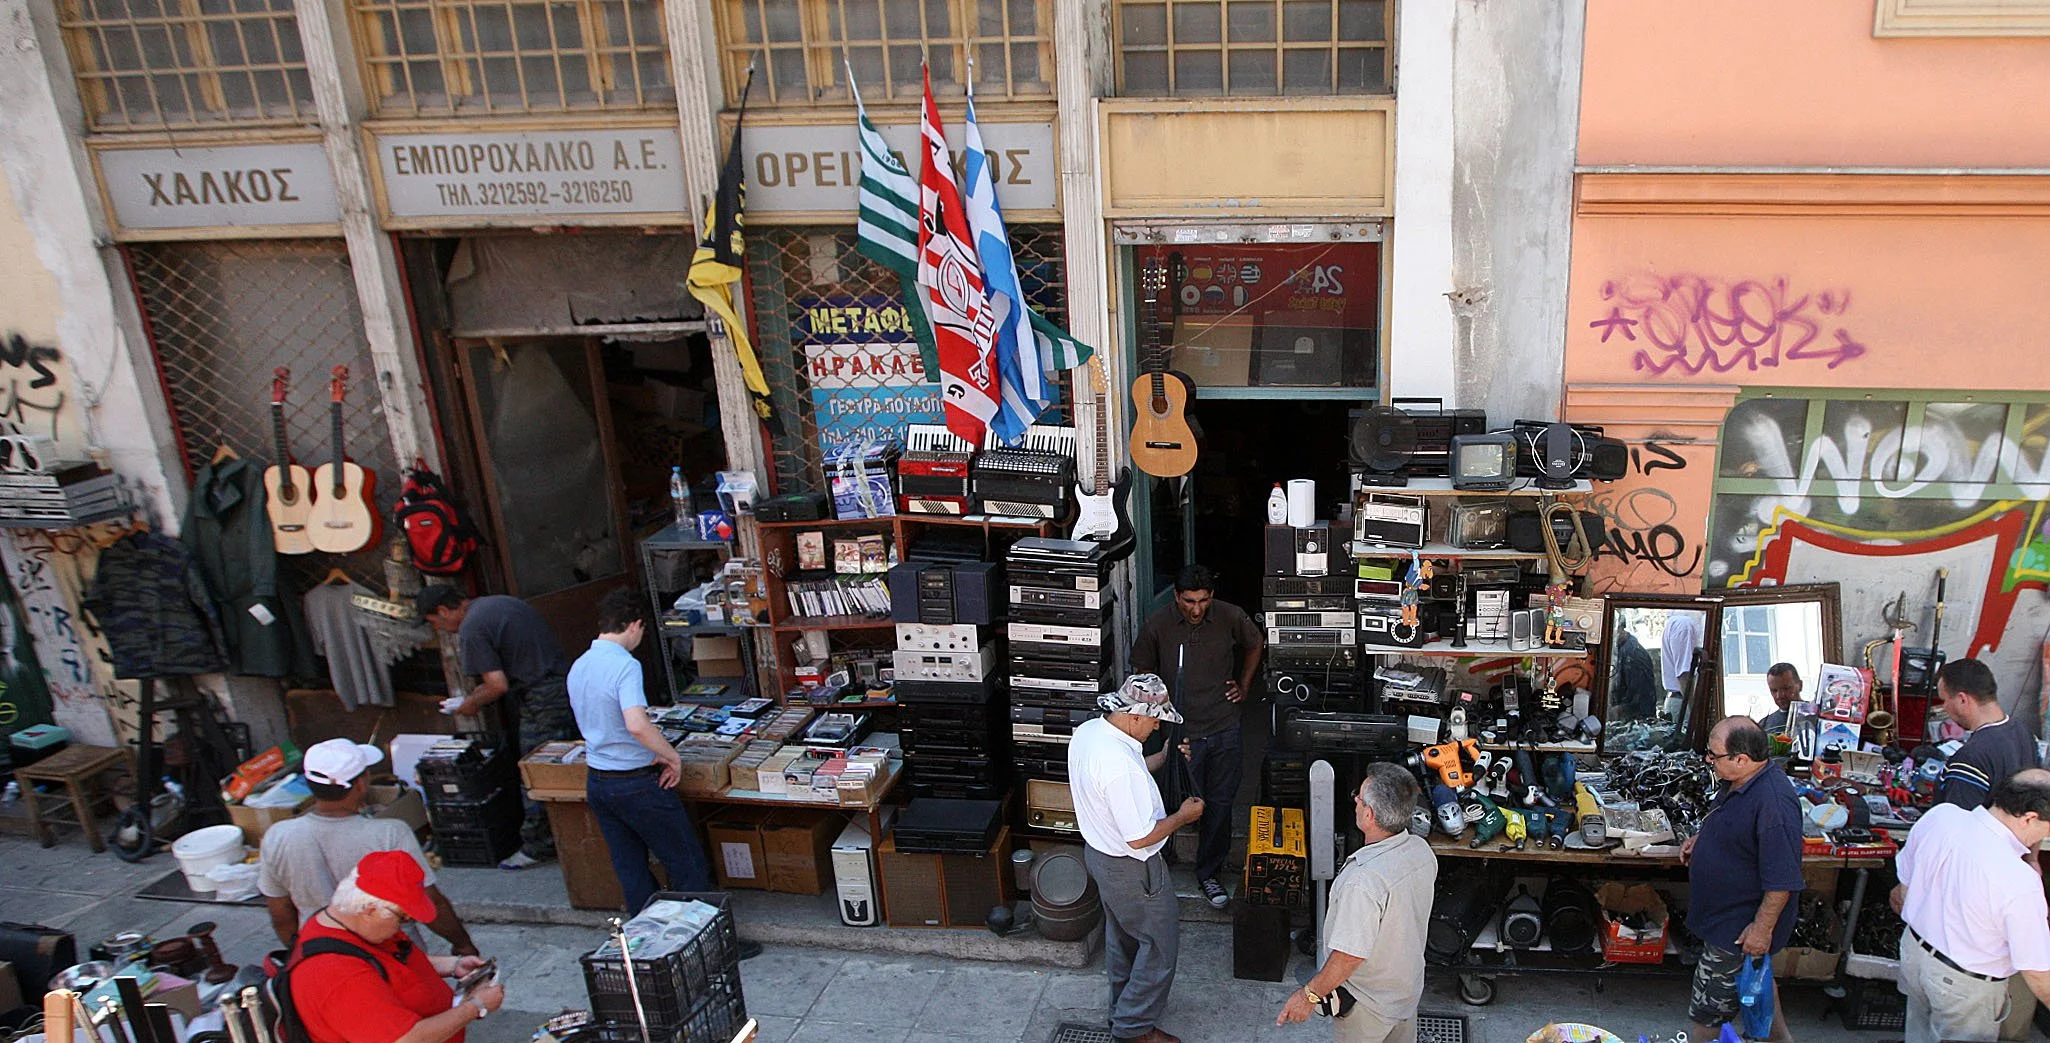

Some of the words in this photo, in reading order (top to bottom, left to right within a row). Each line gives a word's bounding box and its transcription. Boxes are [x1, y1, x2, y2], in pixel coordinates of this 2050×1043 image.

[392, 140, 595, 175] ΕΜΠΟΡΟΧΑΛΚΟ
[613, 138, 668, 170] Α.Ε.
[141, 168, 300, 206] ΧΑΛΚΟΣ
